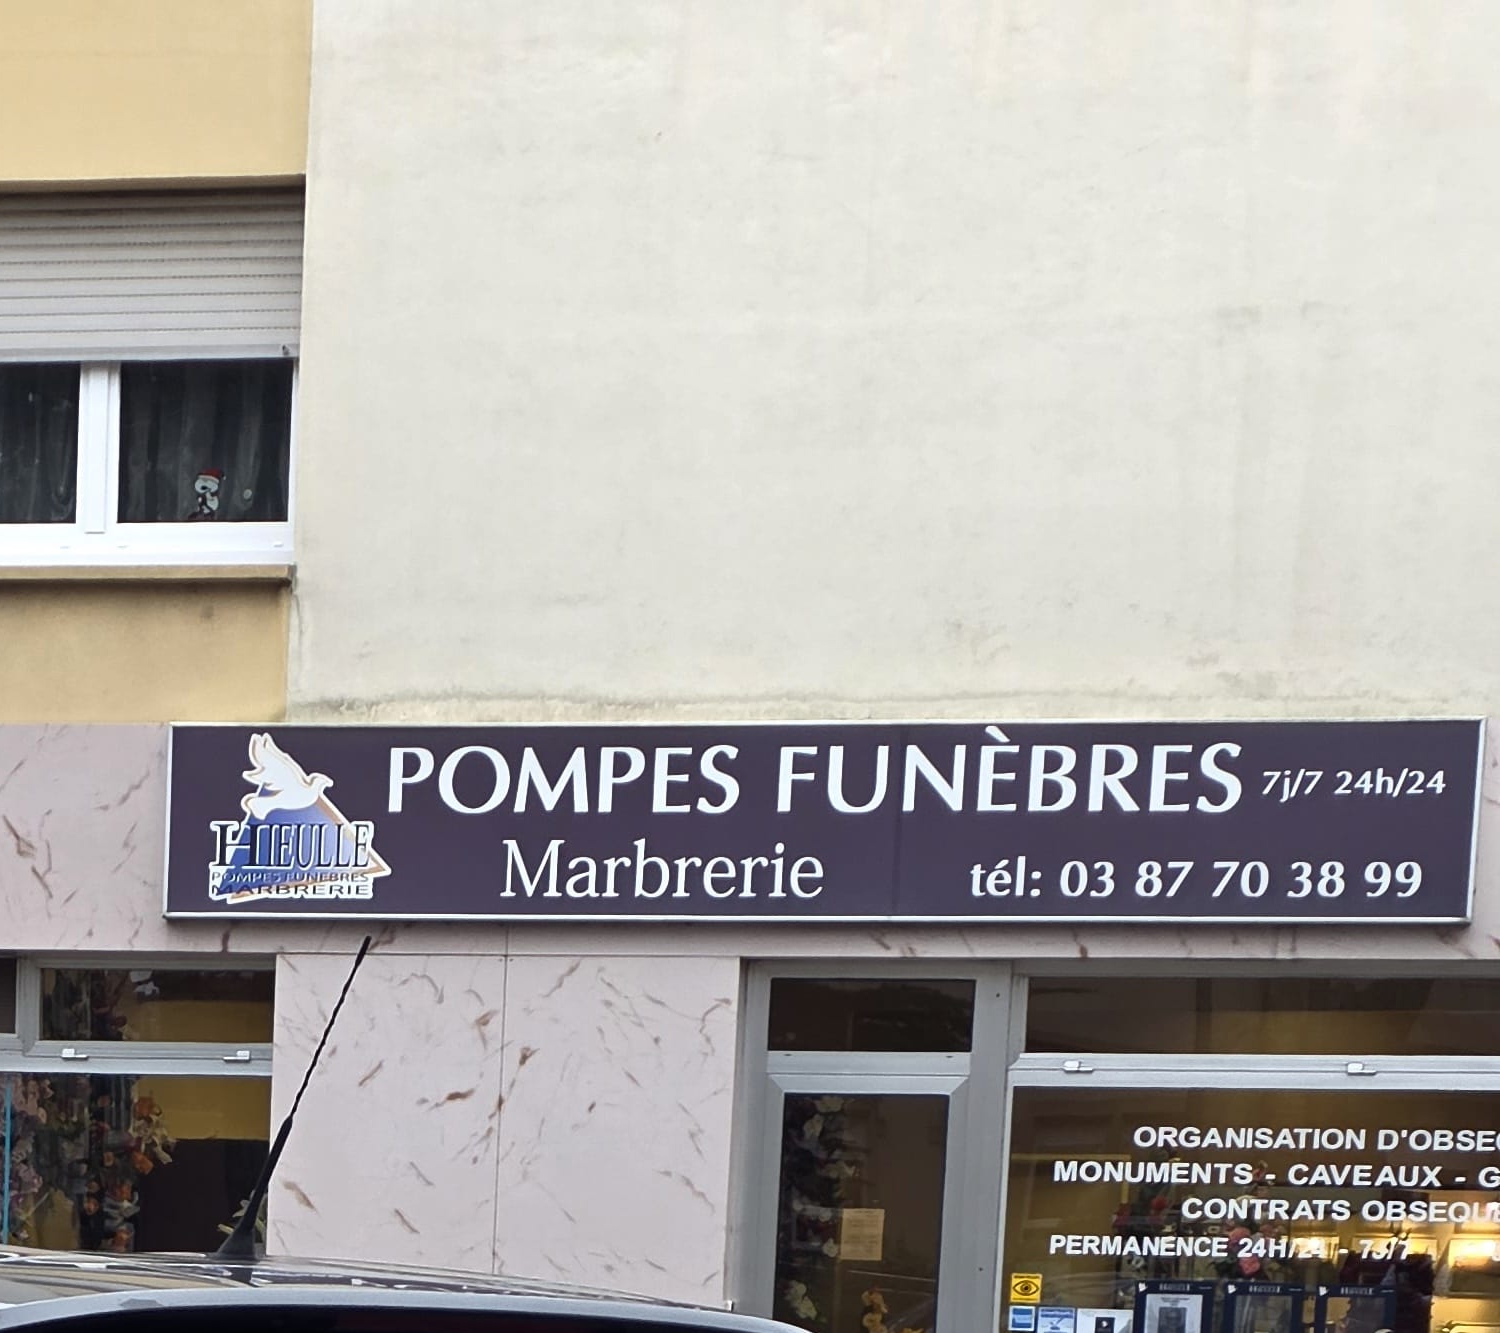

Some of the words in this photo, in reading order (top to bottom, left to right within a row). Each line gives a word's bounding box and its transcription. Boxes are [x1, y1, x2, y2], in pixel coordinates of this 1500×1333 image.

[387, 743, 741, 816] POMPES
[777, 725, 1243, 815] FUNÈBRES
[1262, 769, 1322, 804] 7j/7
[1334, 767, 1447, 797] 24h/24
[211, 822, 371, 867] HIEULLE
[500, 837, 823, 898] Marbrerie
[970, 855, 1042, 898] tél:
[1059, 859, 1114, 898] 03
[1134, 860, 1194, 898] 87
[1212, 860, 1269, 898] 70
[1287, 860, 1345, 898] 38
[1363, 860, 1423, 898] 99
[211, 884, 369, 896] MARBRERIE
[1133, 1126, 1367, 1151] ORGANISATION
[1377, 1128, 1500, 1152] D'OBSE
[1053, 1160, 1253, 1185] MONUMENTS
[1287, 1164, 1443, 1188] CAVEAUX
[1181, 1197, 1351, 1221] CONTRATS
[1049, 1234, 1229, 1257] PERMANENCE
